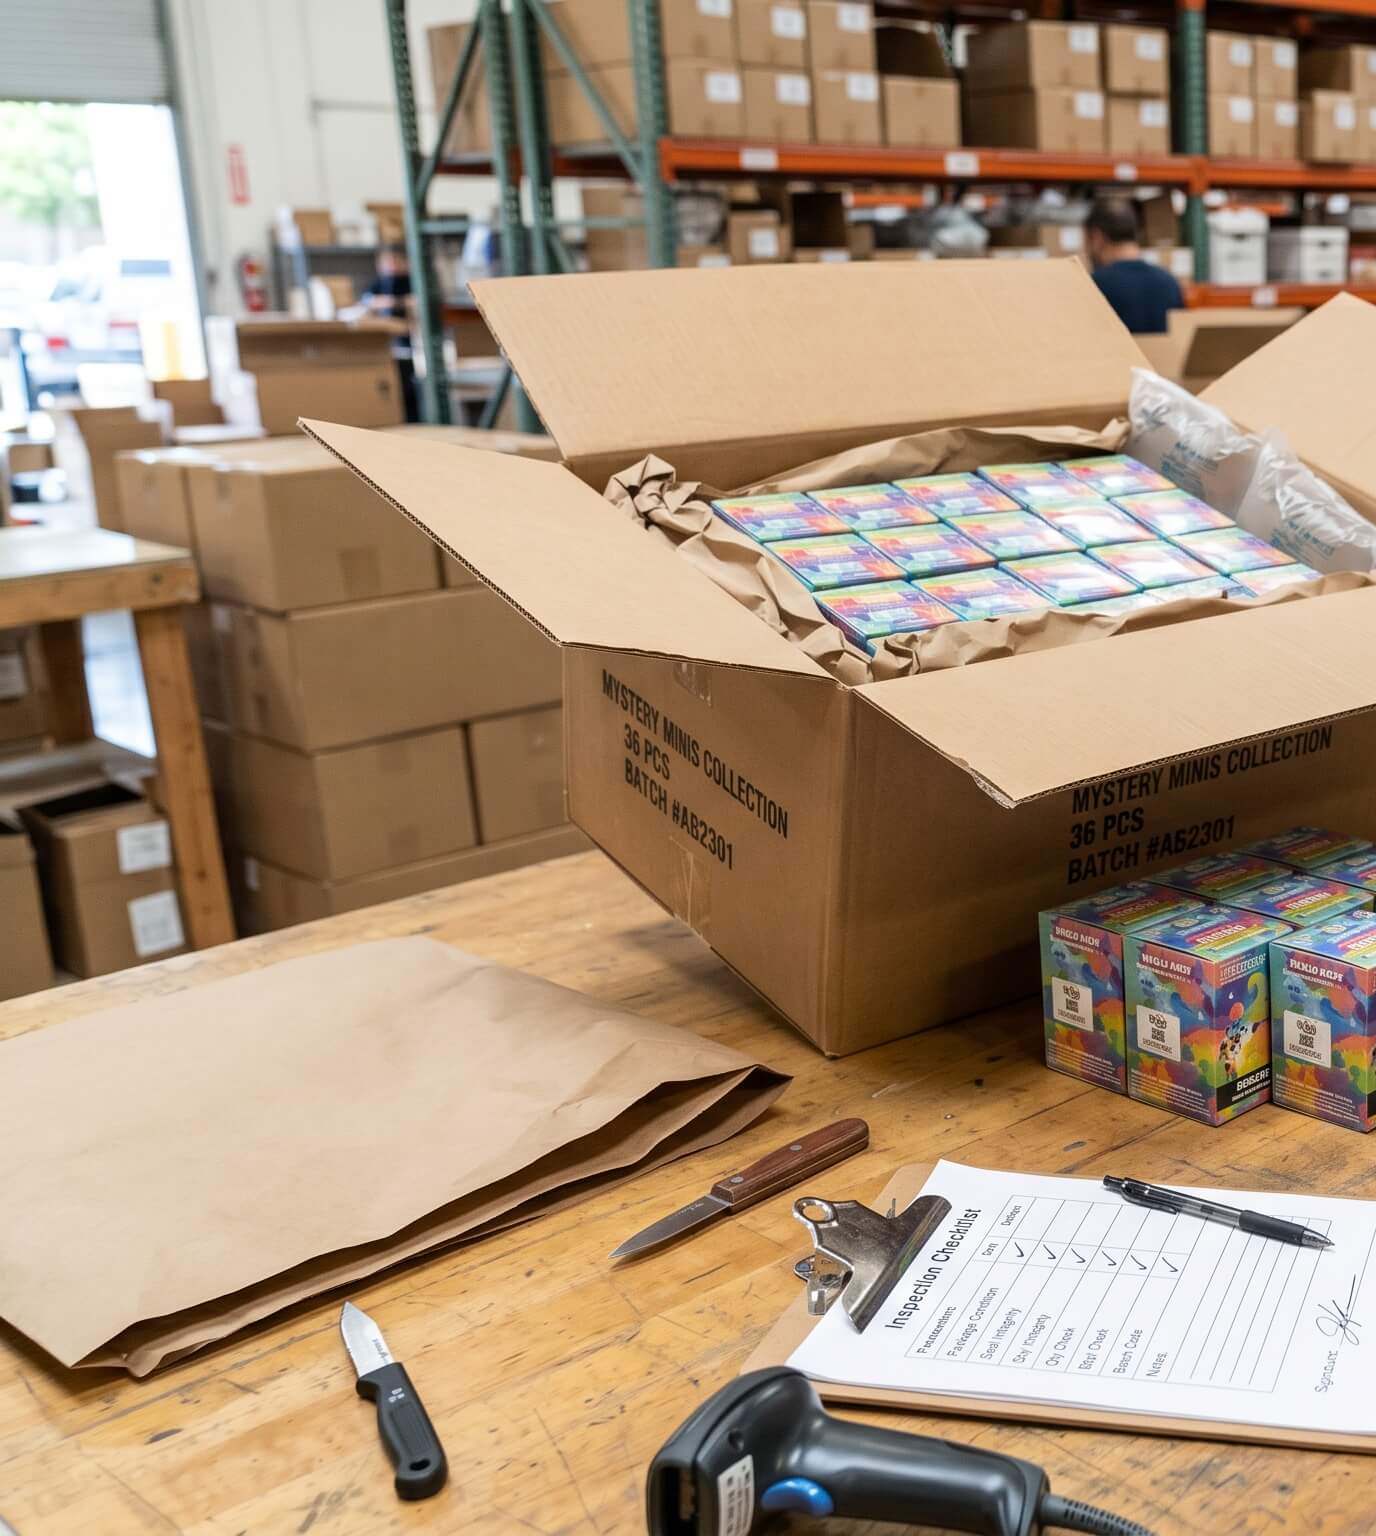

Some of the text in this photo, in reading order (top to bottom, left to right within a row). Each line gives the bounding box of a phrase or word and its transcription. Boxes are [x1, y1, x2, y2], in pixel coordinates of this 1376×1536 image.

[603, 669, 788, 839] MYSTERY MINIS COLLECTION
[624, 723, 670, 781] 36 PCS
[1072, 726, 1332, 815] MYSTERY MINIS COLLECTION
[625, 759, 733, 871] BATCH #AB2301
[1070, 807, 1144, 849] 36 PCS
[1067, 842, 1139, 885] BATCH
